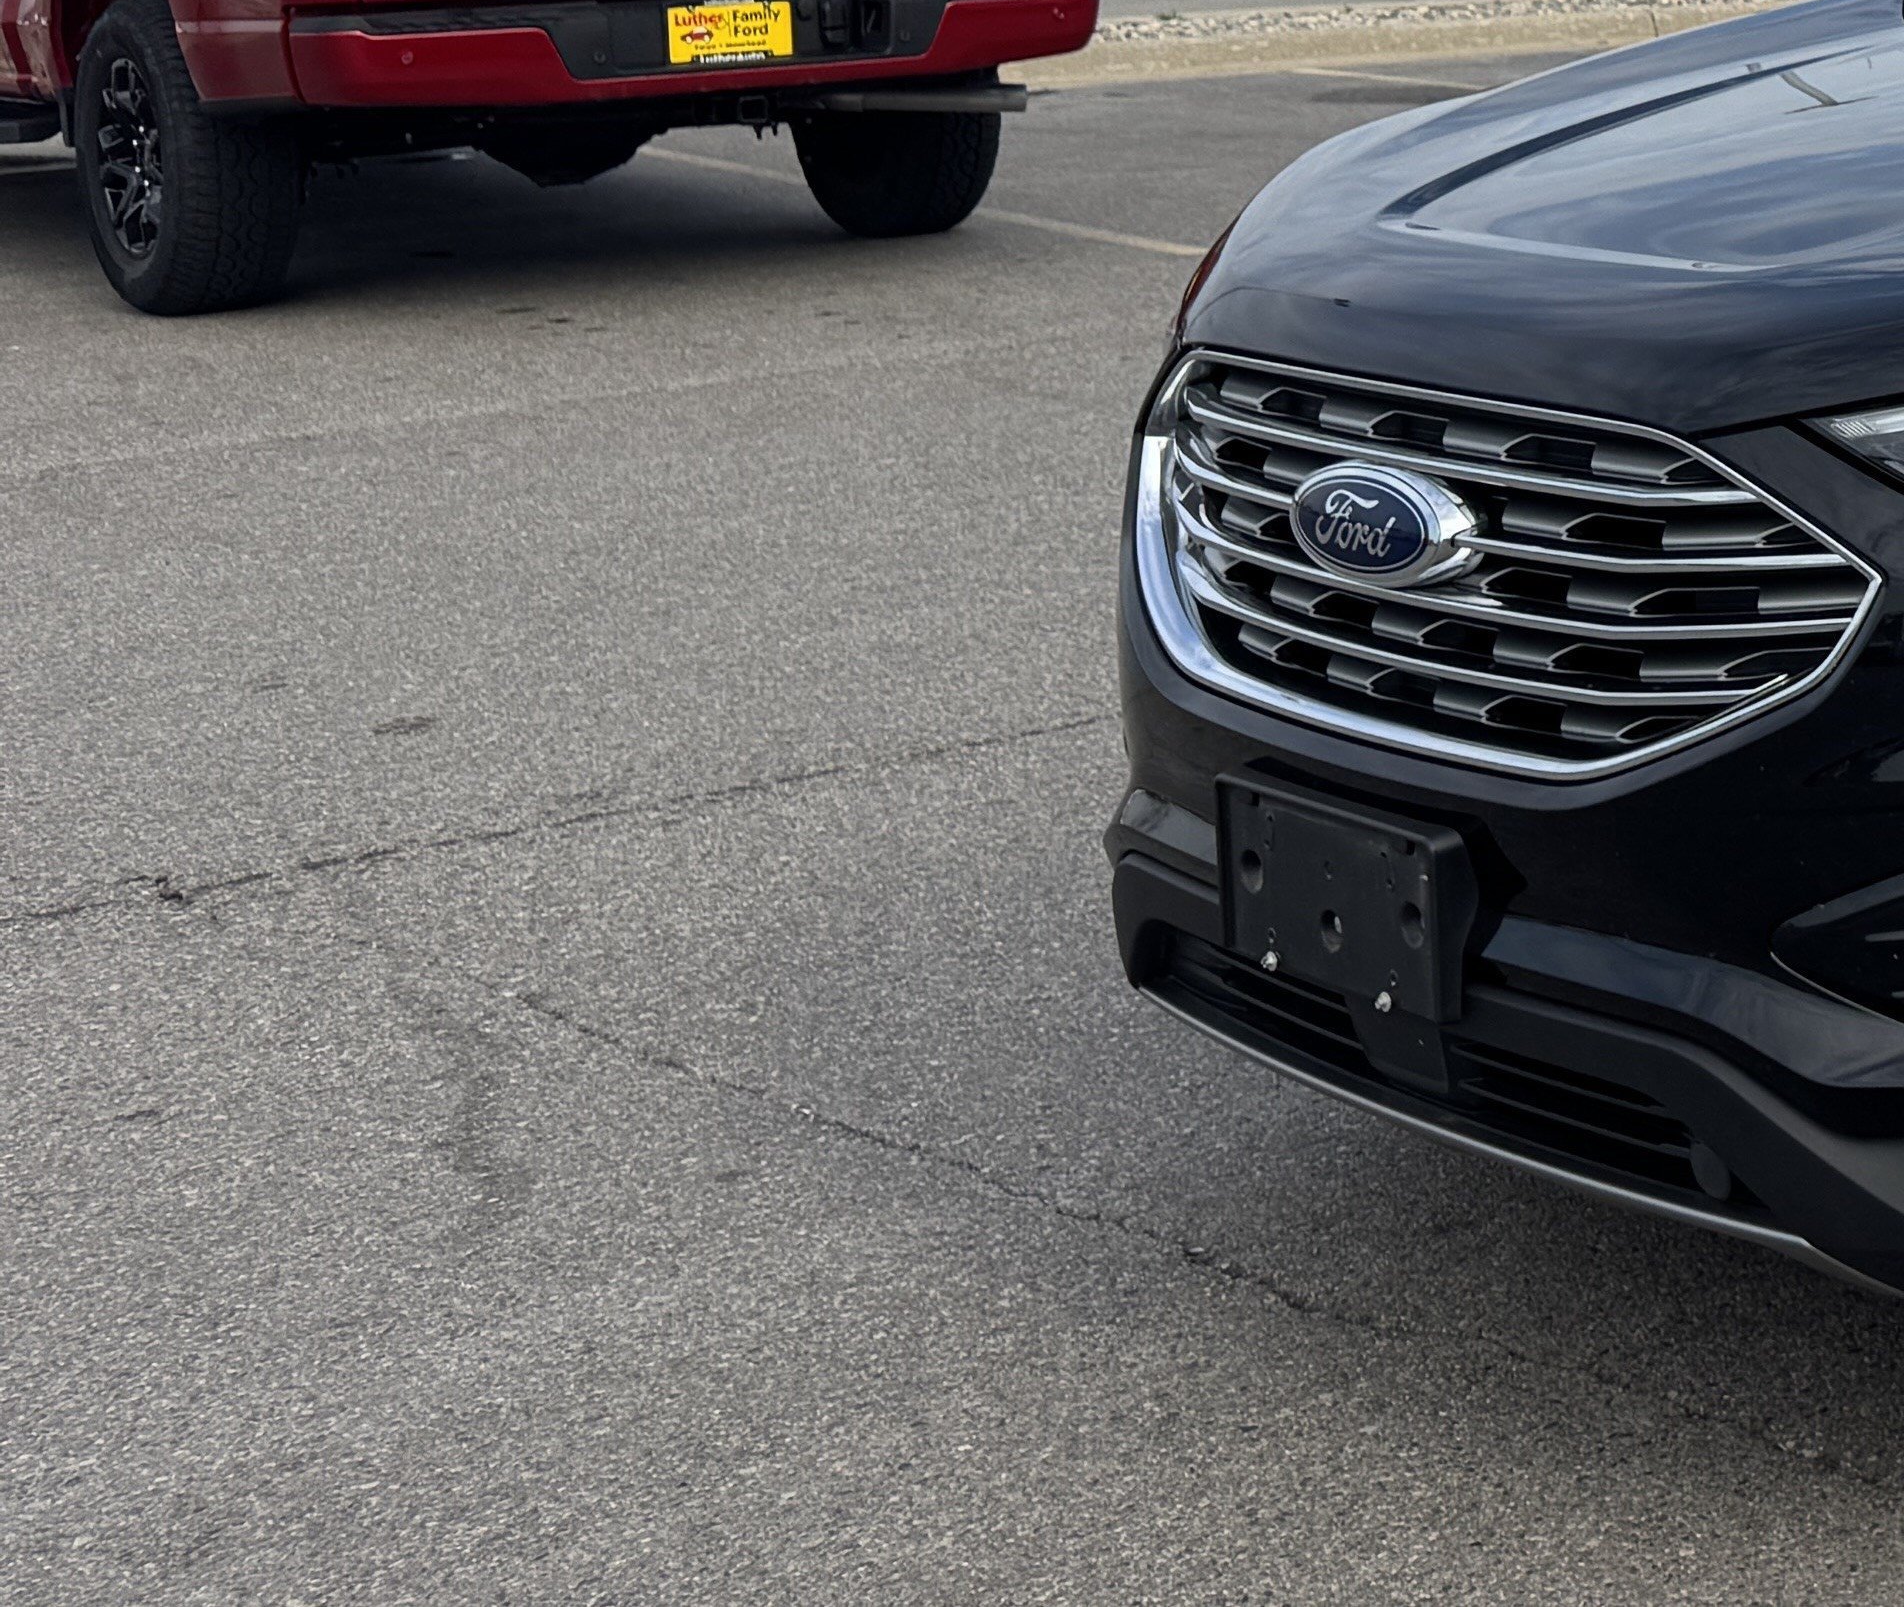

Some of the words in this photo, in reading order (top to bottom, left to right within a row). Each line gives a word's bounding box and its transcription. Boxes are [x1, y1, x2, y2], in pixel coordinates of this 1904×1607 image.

[674, 11, 724, 27] Luther
[732, 8, 781, 23] Family
[733, 23, 769, 38] Ford
[1314, 488, 1397, 558] Ford
